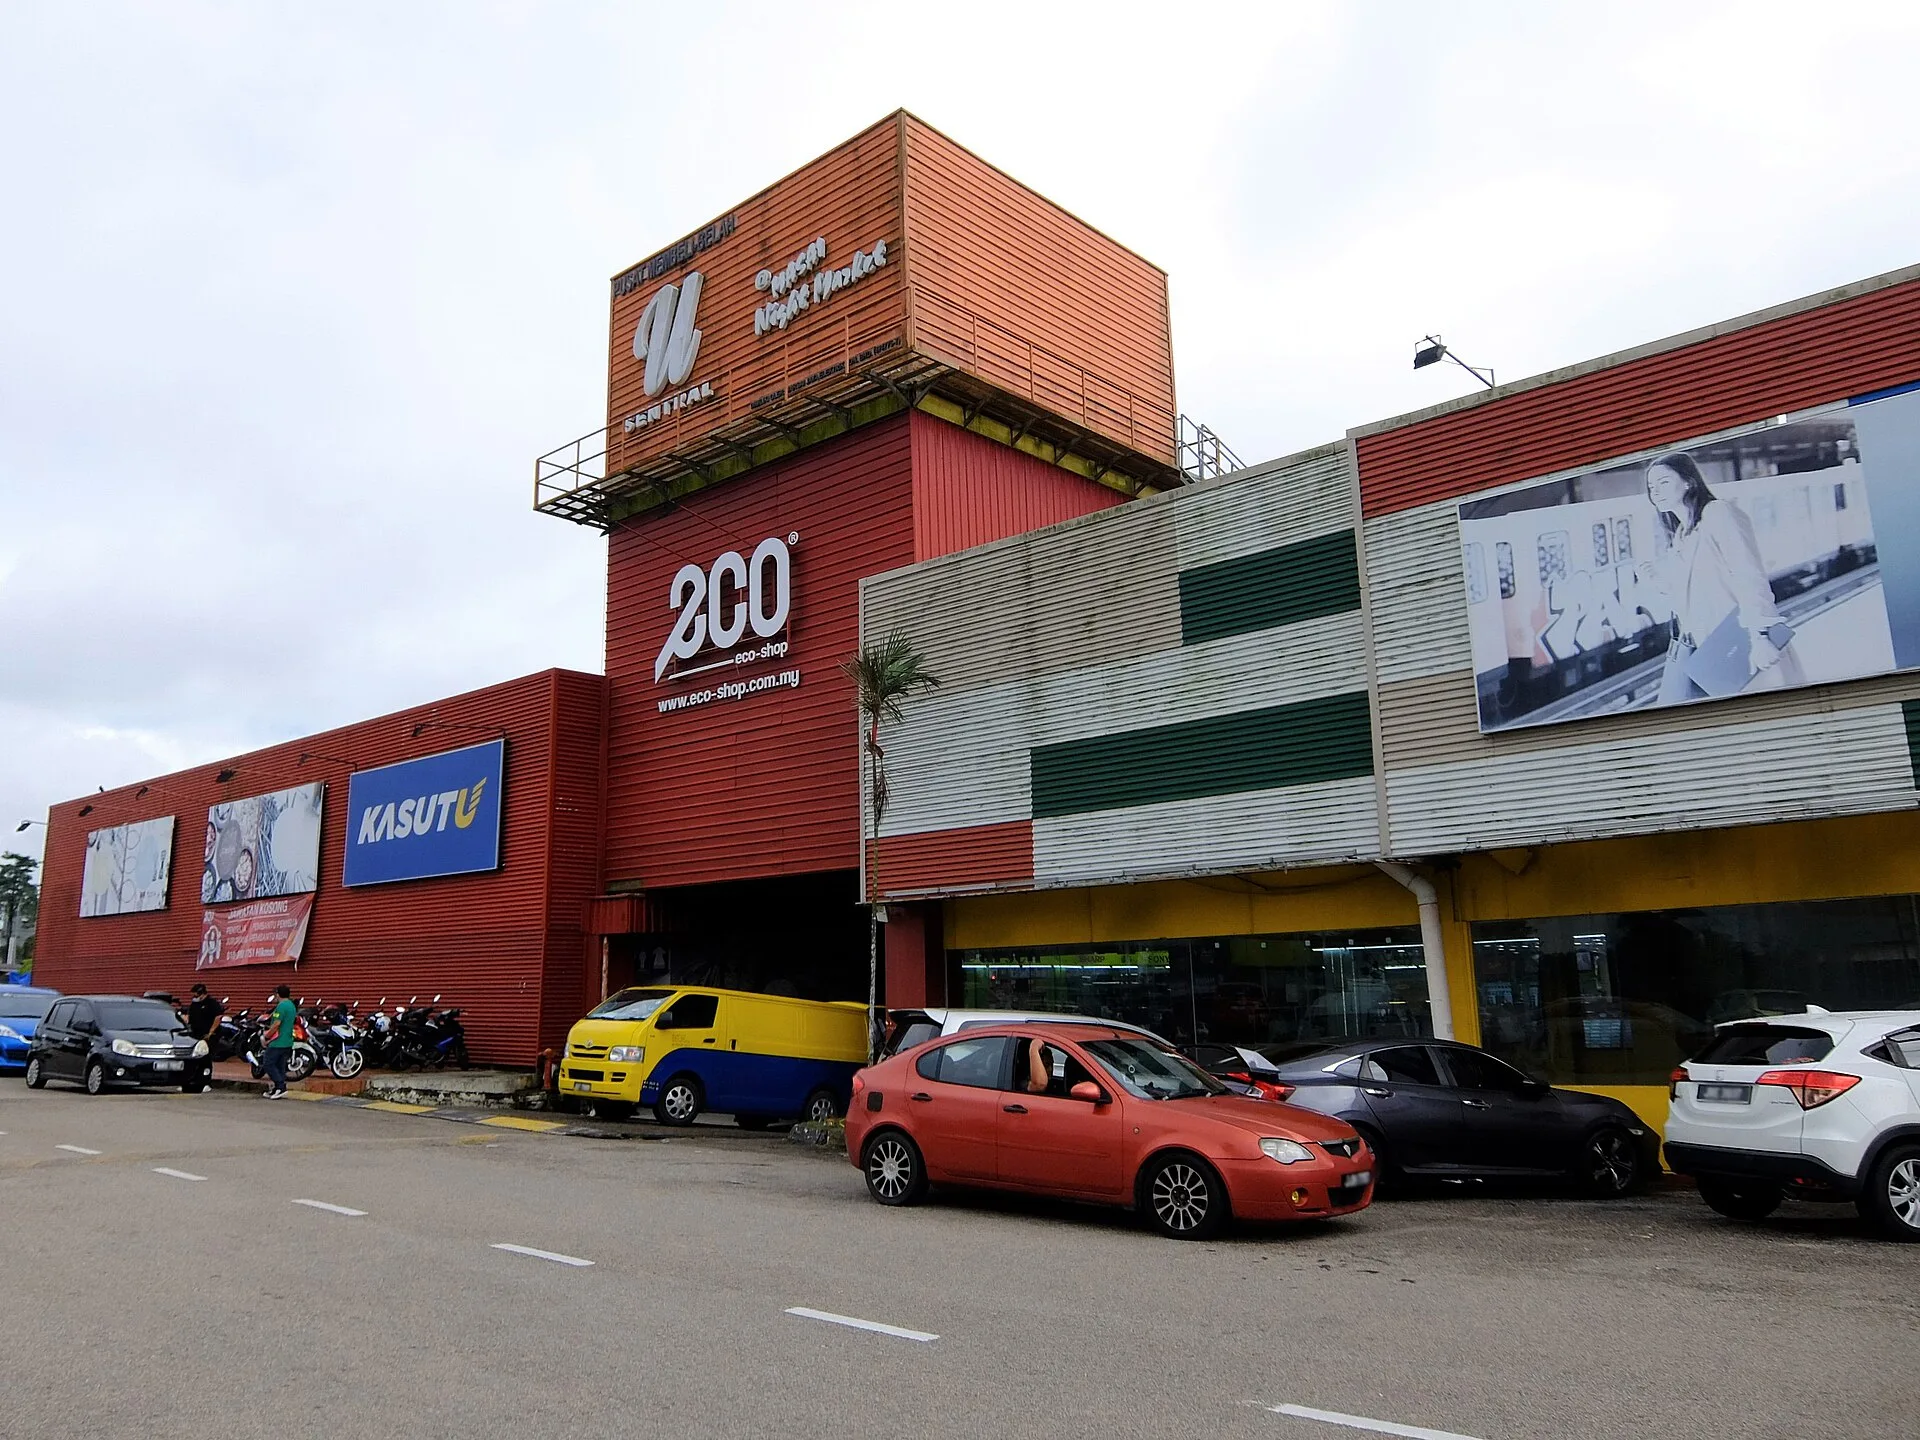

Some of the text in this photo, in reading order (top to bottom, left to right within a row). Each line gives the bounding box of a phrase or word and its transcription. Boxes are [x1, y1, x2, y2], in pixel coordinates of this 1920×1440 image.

[625, 382, 714, 433] SENTRAL
[735, 641, 788, 665] eco-shop
[658, 669, 800, 713] www.eco-shop.com.my
[357, 777, 487, 845] KASUTU
[260, 900, 288, 916] KOSONG
